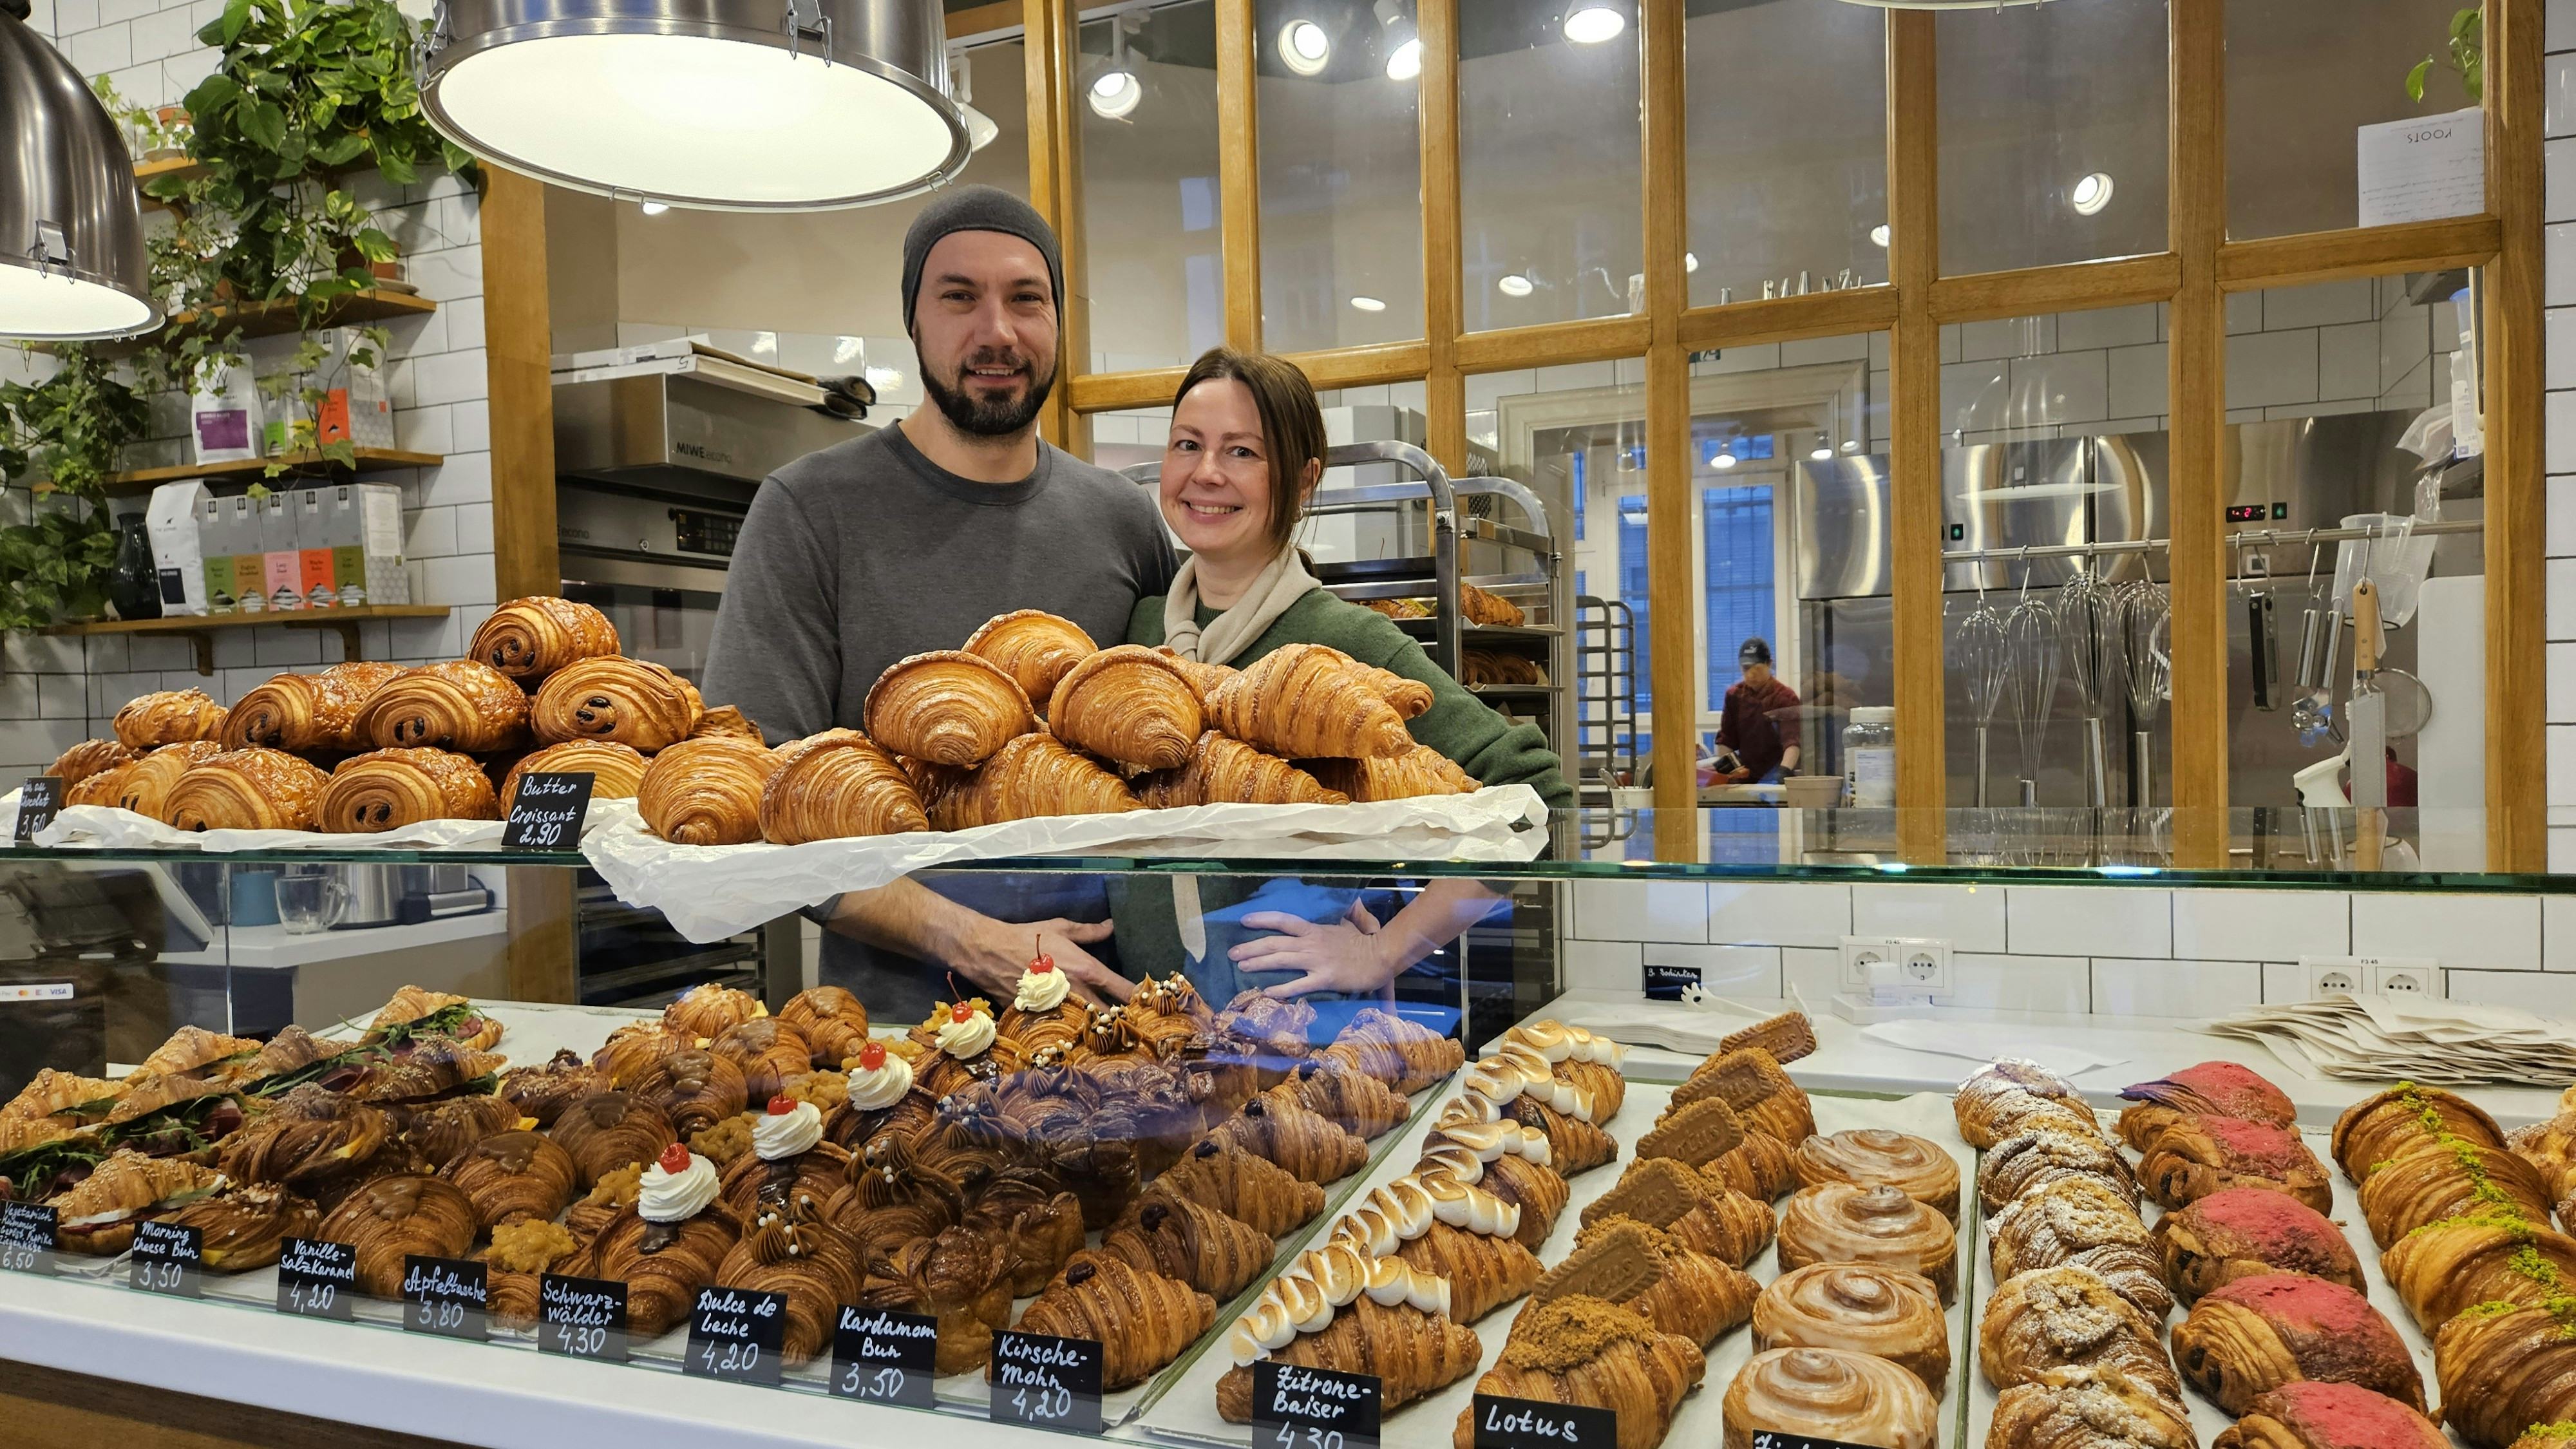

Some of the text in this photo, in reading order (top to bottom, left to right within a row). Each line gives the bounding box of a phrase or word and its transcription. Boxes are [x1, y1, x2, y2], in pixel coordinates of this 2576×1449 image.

[676, 441, 705, 459] MIWE
[522, 775, 577, 796] Butter
[509, 805, 576, 824] Croissant
[519, 822, 562, 846] 2,90
[133, 1237, 199, 1259] Cheese Bun
[142, 1221, 189, 1246] Morning
[3, 1251, 33, 1271] 6,50
[294, 1239, 346, 1261] Vanille-
[139, 1261, 182, 1291] 3,50
[404, 1265, 486, 1302] Apfeltasche
[290, 1280, 334, 1312] 4,20
[543, 1280, 622, 1309] Schwarz-
[697, 1289, 777, 1318] Dulce de
[419, 1300, 464, 1329] 3,80
[701, 1312, 749, 1338] Leche
[840, 1306, 938, 1339] Kardamom
[557, 1323, 606, 1354] 4,30
[861, 1336, 901, 1358] Bun
[999, 1334, 1088, 1367] Kirsche-
[701, 1340, 759, 1374] 4,20
[842, 1363, 904, 1397] 3,50
[1001, 1363, 1063, 1391] Mohn
[1276, 1365, 1372, 1399] Zitrone-
[1012, 1387, 1072, 1421] 4,20
[1273, 1390, 1345, 1419] Baiser
[1485, 1404, 1578, 1443] Lotus
